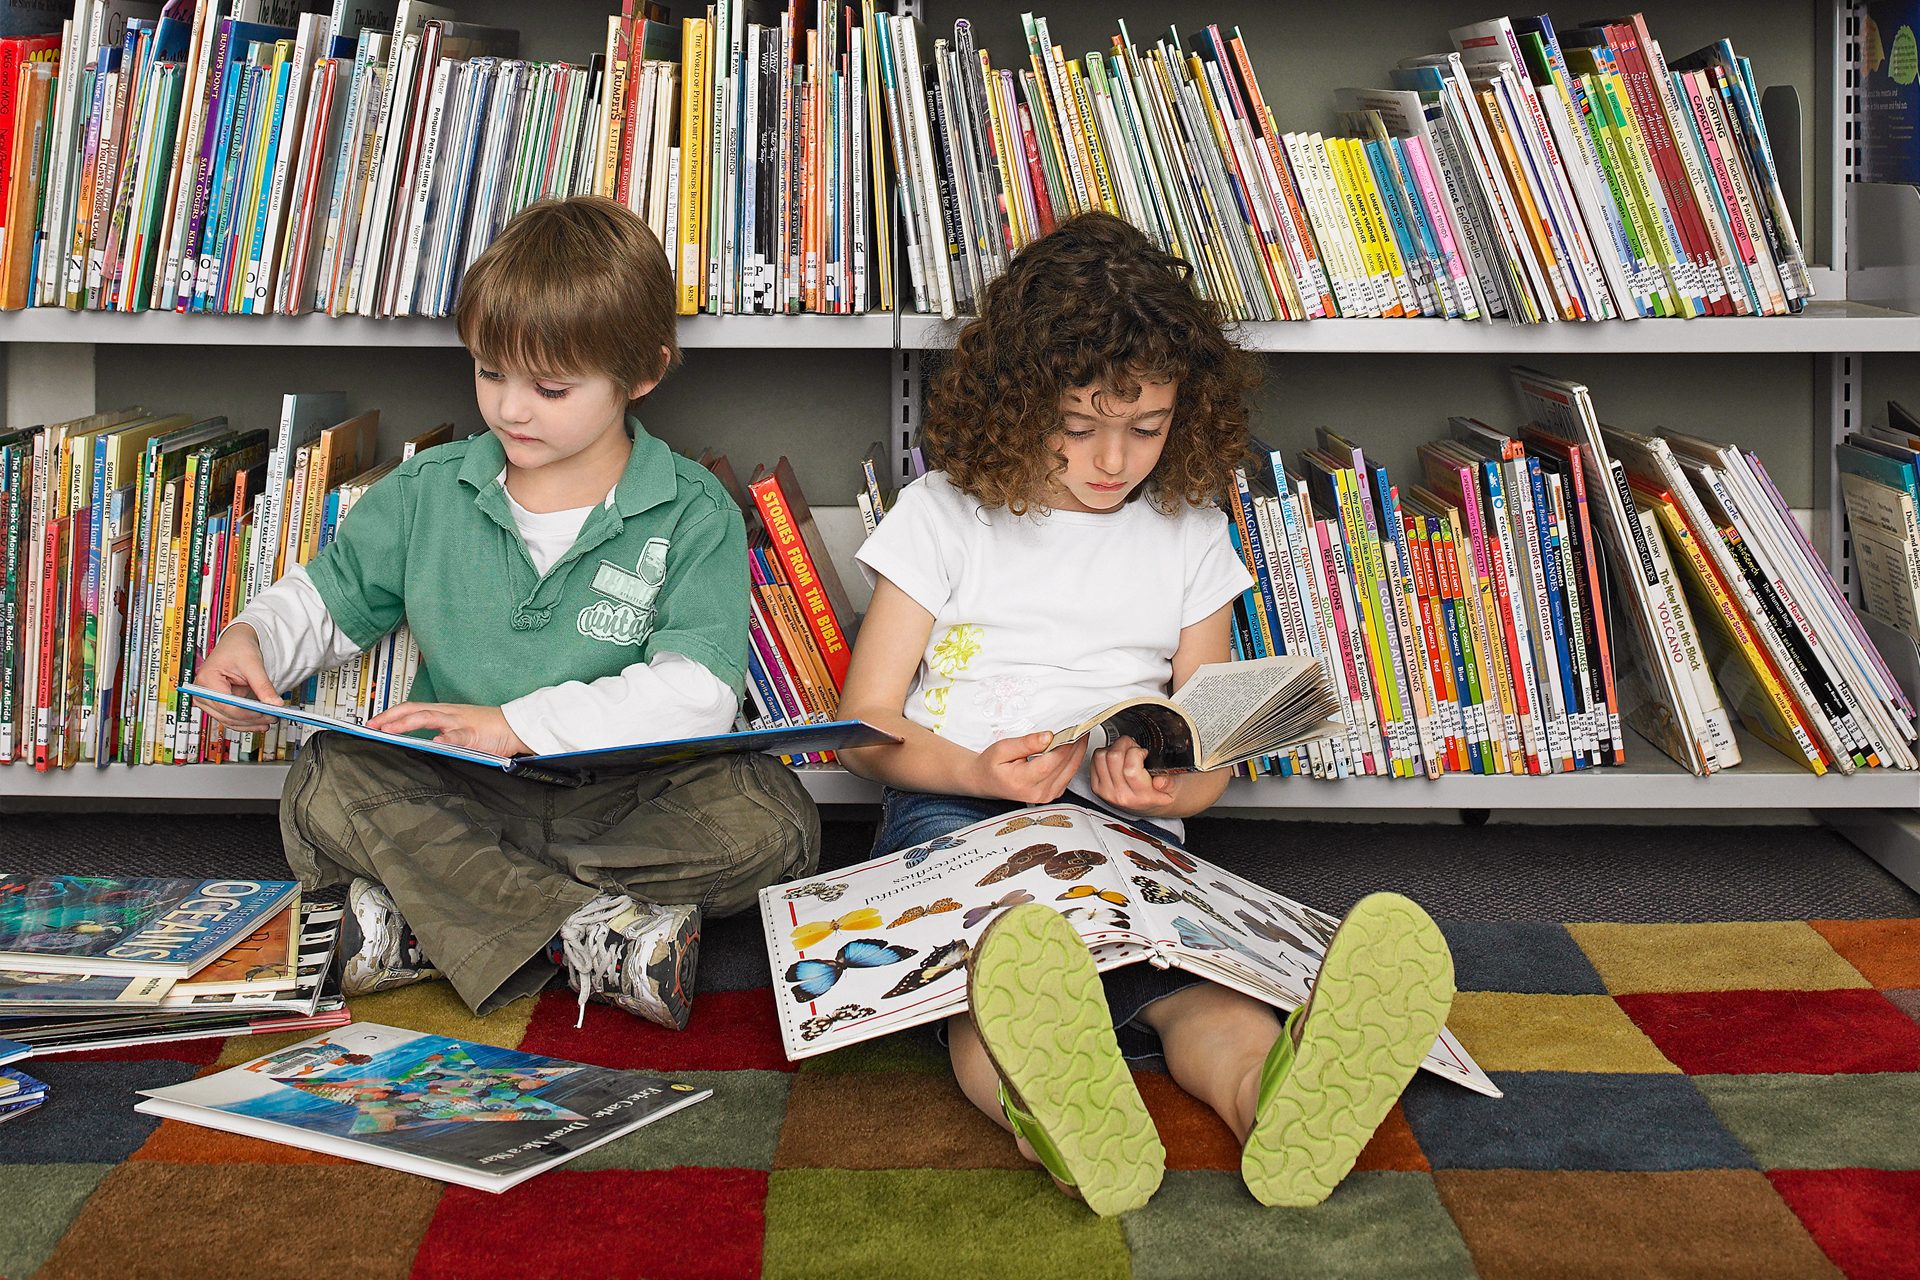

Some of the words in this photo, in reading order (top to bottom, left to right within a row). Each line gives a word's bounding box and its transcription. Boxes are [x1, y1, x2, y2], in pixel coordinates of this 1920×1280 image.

[216, 33, 227, 68] BUNYIPS
[392, 30, 401, 46] Mice
[3, 49, 12, 68] MEG
[388, 61, 396, 72] the
[2, 71, 11, 86] and
[95, 72, 105, 98] Whose
[211, 71, 222, 99] DON'T
[694, 79, 700, 88] OF
[1072, 72, 1080, 86] THE
[0, 90, 10, 114] MOG
[381, 74, 394, 109] Clockwork
[611, 67, 625, 121] TRUMPET'S
[380, 111, 388, 124] Bus
[927, 90, 936, 121] Brennan
[1075, 87, 1091, 123] ORIGIN
[1705, 96, 1725, 139] SORTING
[430, 108, 440, 135] Penguin
[1085, 125, 1093, 134] OF
[1528, 94, 1539, 113] SUPER
[1534, 114, 1549, 139] SCIENCE
[1543, 140, 1558, 165] MODELS
[1693, 95, 1714, 143] CAPACITY
[88, 126, 98, 147] That?
[427, 138, 435, 154] Pete
[714, 115, 722, 154] PRATER
[1088, 134, 1099, 154] LIFE
[1571, 93, 1587, 125] WINTER
[1581, 127, 1590, 136] IN
[1586, 138, 1606, 183] AUSTRALIA
[197, 157, 208, 182] SALLY
[425, 155, 433, 168] and
[1094, 154, 1104, 168] ON
[1430, 130, 1438, 143] The
[1436, 148, 1446, 167] little
[1441, 169, 1460, 203] Science
[421, 170, 430, 188] Little
[690, 159, 698, 189] FRIENDS
[1097, 168, 1111, 201] EARTH
[191, 184, 203, 219] ODGERS
[419, 190, 427, 202] Tim
[943, 196, 951, 207] for
[1727, 158, 1745, 194] Pluckrose
[1743, 203, 1760, 241] Fairclough
[945, 210, 955, 243] Australia
[1369, 193, 1381, 217] ELMER'S
[1375, 218, 1389, 243] WEATHER
[94, 457, 103, 474] The
[11, 472, 19, 501] Deltora
[91, 477, 102, 500] Long
[1352, 491, 1360, 505] Why
[91, 502, 100, 520] Way
[162, 492, 173, 537] MAUREEN
[1274, 464, 1287, 493] DISCOVER
[1281, 501, 1294, 525] SCIENCE
[1288, 532, 1304, 569] FLIGHT
[1354, 506, 1363, 523] can't
[10, 525, 17, 534] of
[90, 523, 98, 550] Home
[182, 522, 190, 545] Shoes
[1242, 502, 1265, 569] MAGNETISM
[1363, 497, 1377, 530] LOOK
[1371, 542, 1384, 579] LEARN
[1614, 470, 1632, 505] COLLINS
[1624, 505, 1646, 552] EYEWITNESS
[1642, 553, 1656, 582] GUIDES
[8, 536, 16, 571] Monsters
[46, 533, 55, 559] Game
[158, 542, 169, 575] ROFFEY
[1361, 543, 1369, 554] like
[45, 561, 53, 579] Plan
[762, 491, 795, 544] STORIES
[787, 547, 813, 587] FROM
[805, 587, 825, 614] THE
[815, 615, 842, 653] BIBLE
[1280, 550, 1293, 580] FLYING
[1333, 544, 1346, 575] LIGHT
[1364, 562, 1373, 577] lion?
[1561, 536, 1573, 587] VOLCANOES
[1712, 482, 1727, 499] Eric
[1723, 500, 1740, 520] Carle
[1774, 580, 1791, 601] From
[1788, 602, 1801, 623] Head
[1801, 623, 1808, 632] to
[1807, 633, 1818, 646] Toe
[178, 564, 187, 587] Shoes
[1261, 577, 1270, 593] Peter
[1324, 549, 1341, 610] REFLECTIONS
[1493, 550, 1507, 597] MAGNETS
[1659, 569, 1674, 585] The
[155, 582, 165, 612] Tinker
[1264, 595, 1274, 612] Riley
[1286, 582, 1298, 600] AND
[1569, 590, 1579, 608] AND
[1664, 586, 1680, 604] New
[5, 603, 14, 623] Emily
[174, 606, 183, 629] Susan
[583, 605, 648, 639] vinta
[1291, 602, 1306, 643] FLOATING
[1457, 606, 1468, 626] Finding
[1672, 605, 1685, 620] Kid
[5, 625, 13, 650] Rodda
[152, 615, 163, 645] Tailor
[1657, 601, 1684, 663] VOLCANO
[1678, 621, 1687, 631] on
[172, 632, 180, 662] Rollings
[1462, 629, 1471, 652] Colours
[1572, 612, 1588, 672] EARTHQUAKES
[1681, 633, 1692, 647] the
[149, 648, 160, 682] Soldier
[1687, 648, 1700, 671] Block
[4, 667, 12, 687] Marc
[1467, 663, 1476, 683] Green
[3, 689, 12, 721] McBride
[892, 848, 979, 885] butterflies
[947, 845, 1014, 875] Twenty
[864, 874, 942, 906] beautiful
[106, 881, 262, 960] OCEANS
[633, 1087, 664, 1101] Eric
[591, 1100, 633, 1118] Carle
[544, 1121, 590, 1140] Draw
[519, 1138, 550, 1151] Me
[479, 1152, 514, 1165] Star
